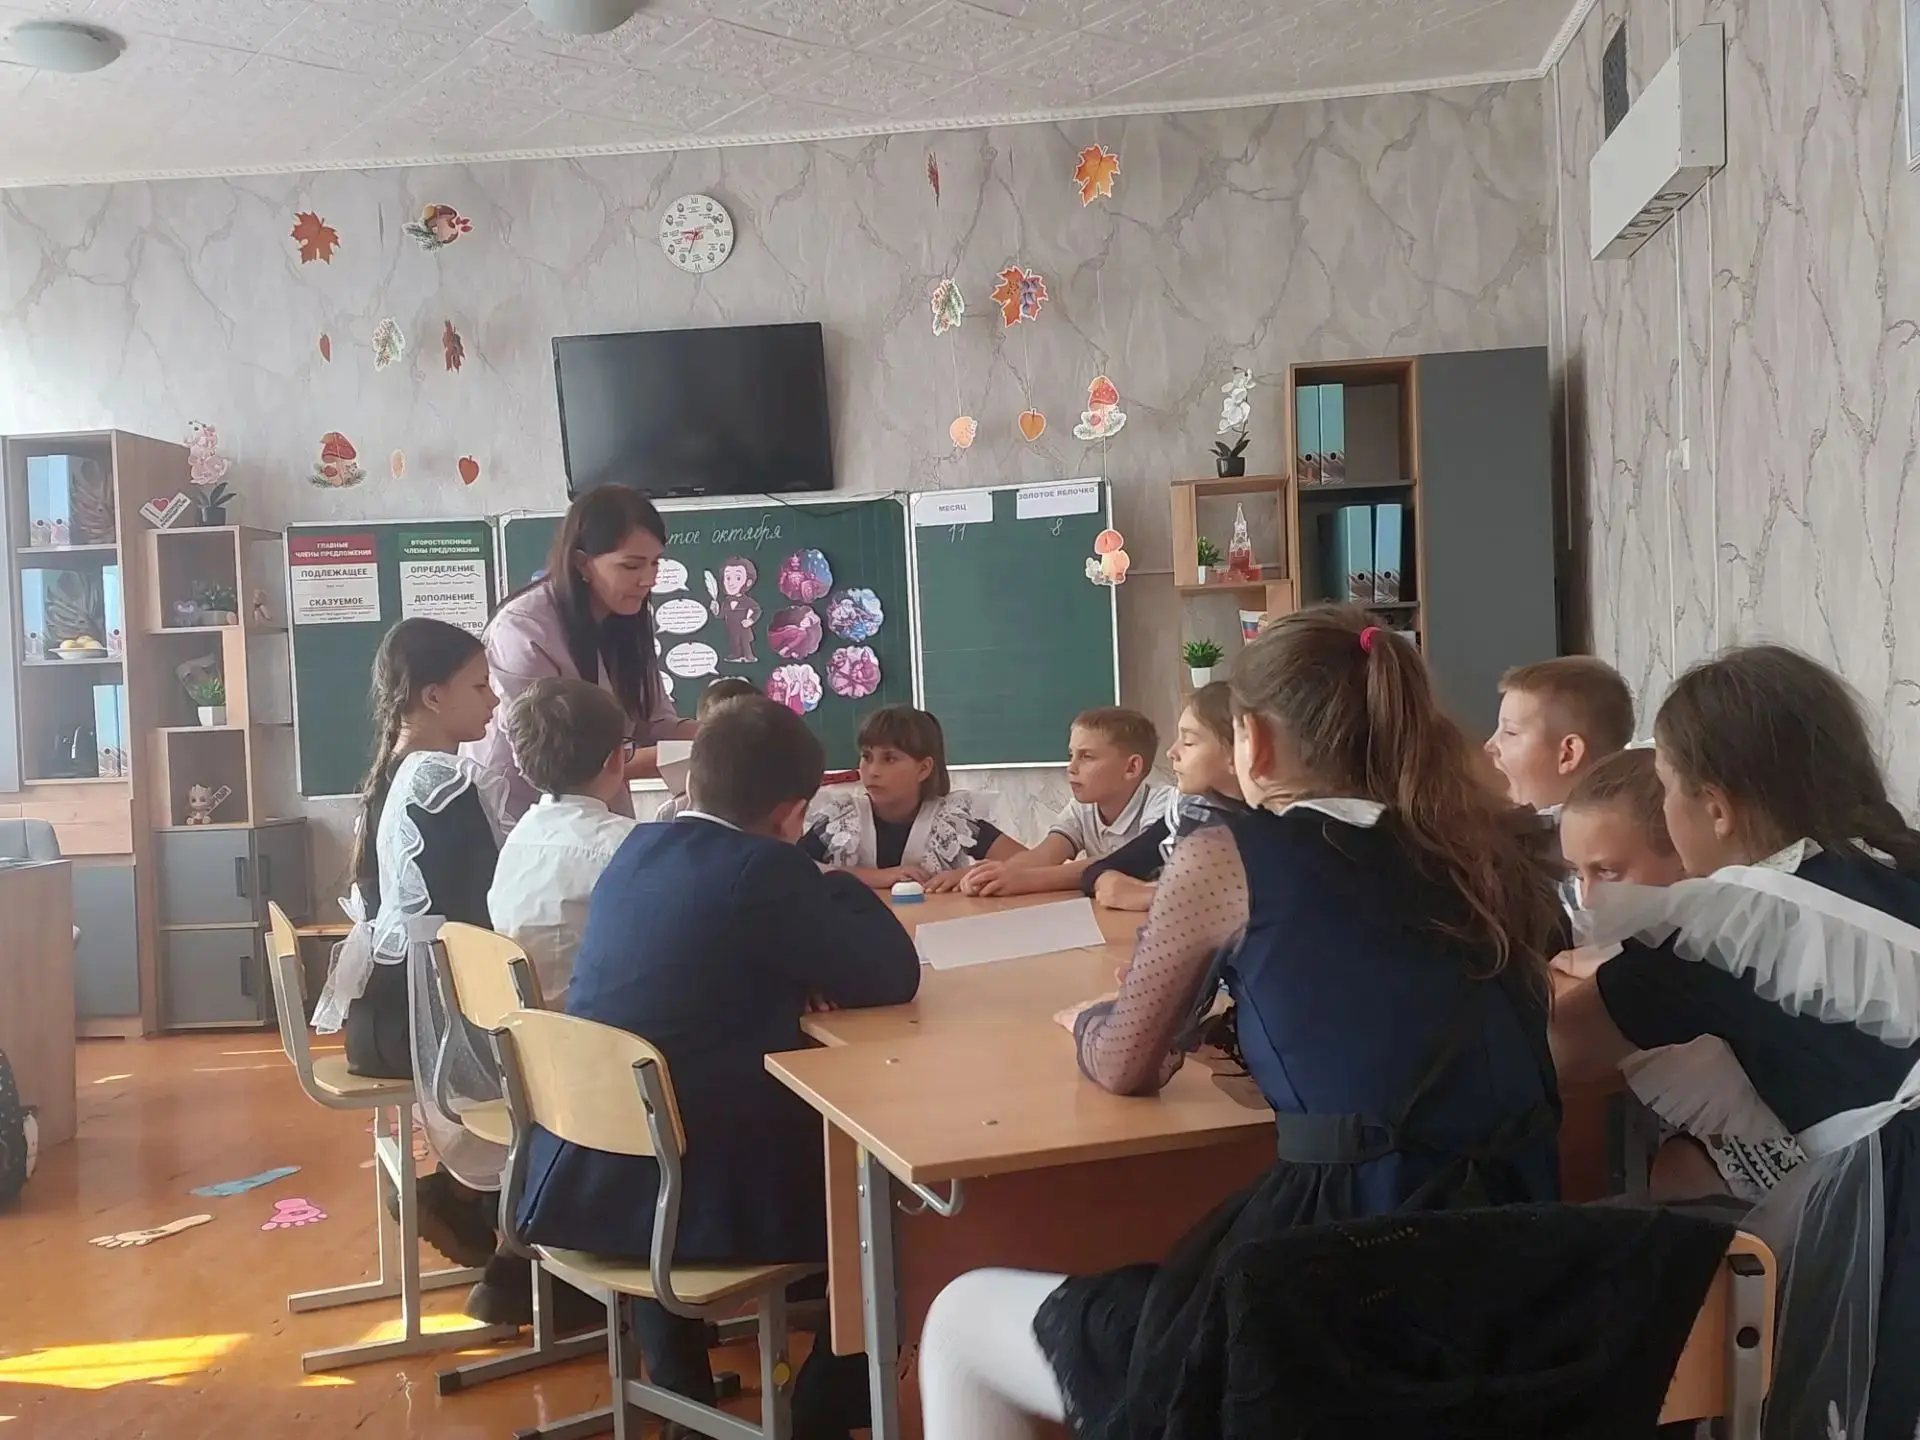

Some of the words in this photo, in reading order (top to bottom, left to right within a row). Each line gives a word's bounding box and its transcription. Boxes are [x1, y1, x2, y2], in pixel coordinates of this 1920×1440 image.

[1018, 490, 1055, 500] ЗОЛОТОЕ
[938, 503, 967, 511] МЕСЯЦ
[1051, 517, 1063, 537] 8
[665, 530, 700, 545] тое
[711, 514, 782, 551] октября
[320, 549, 372, 557] ПРЕДЛОЖЕНИЯ
[429, 546, 480, 554] ПРЕДЛОЖЕНИЯ
[301, 568, 368, 578] ПОДЛЕЖАЩЕЕ
[410, 564, 475, 574] ОПРЕДЕЛЕНИЕ
[309, 597, 364, 607] СКАЗУЕМОЕ
[414, 593, 475, 603] ДОПОЛНЕНИЕ
